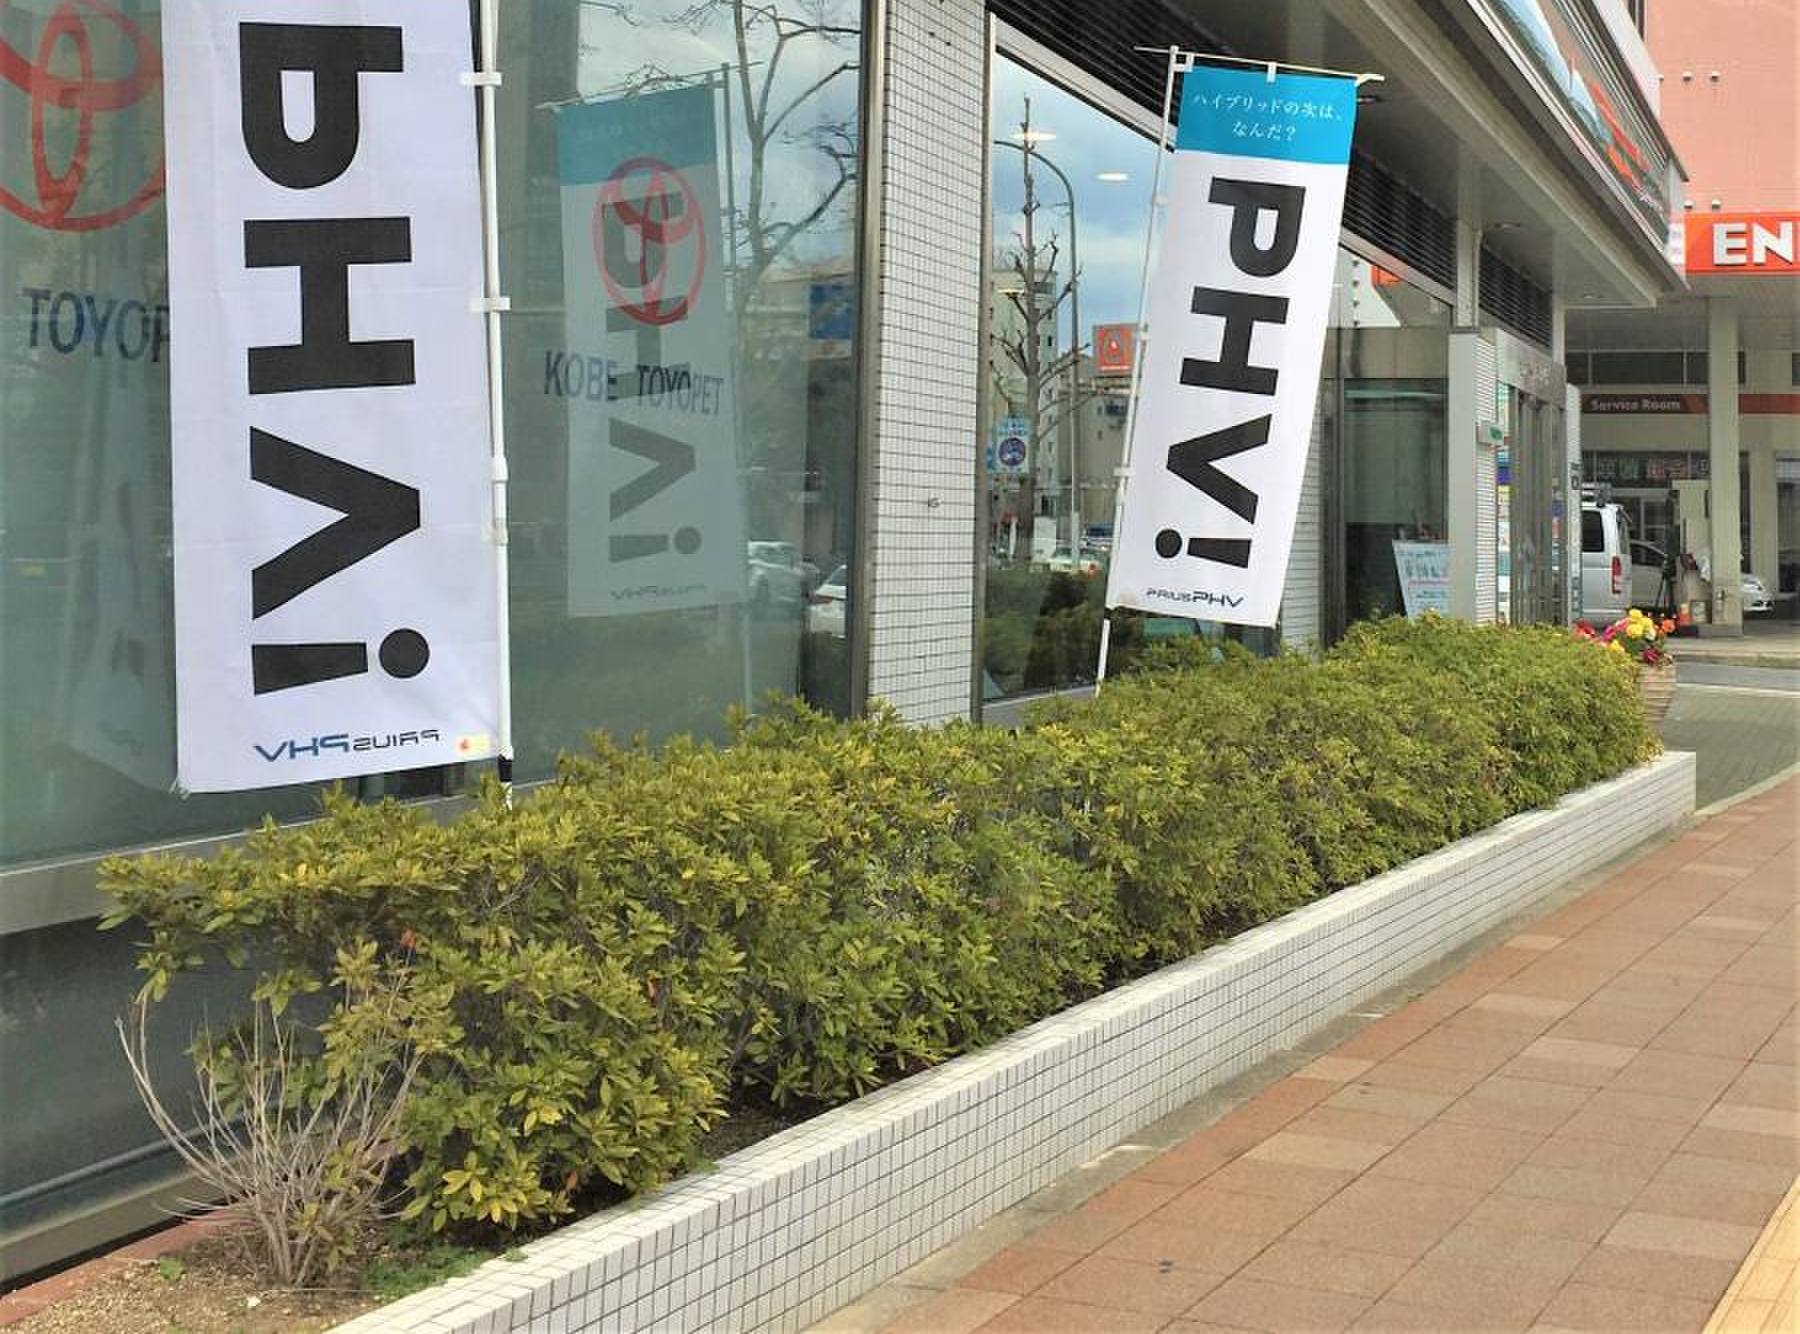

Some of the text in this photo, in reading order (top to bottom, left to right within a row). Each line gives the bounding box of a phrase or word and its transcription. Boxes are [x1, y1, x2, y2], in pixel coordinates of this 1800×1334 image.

[544, 348, 725, 416] KOBE TOYOPET
[1155, 176, 1306, 569] PHV!
[1590, 398, 1681, 411] Service Room
